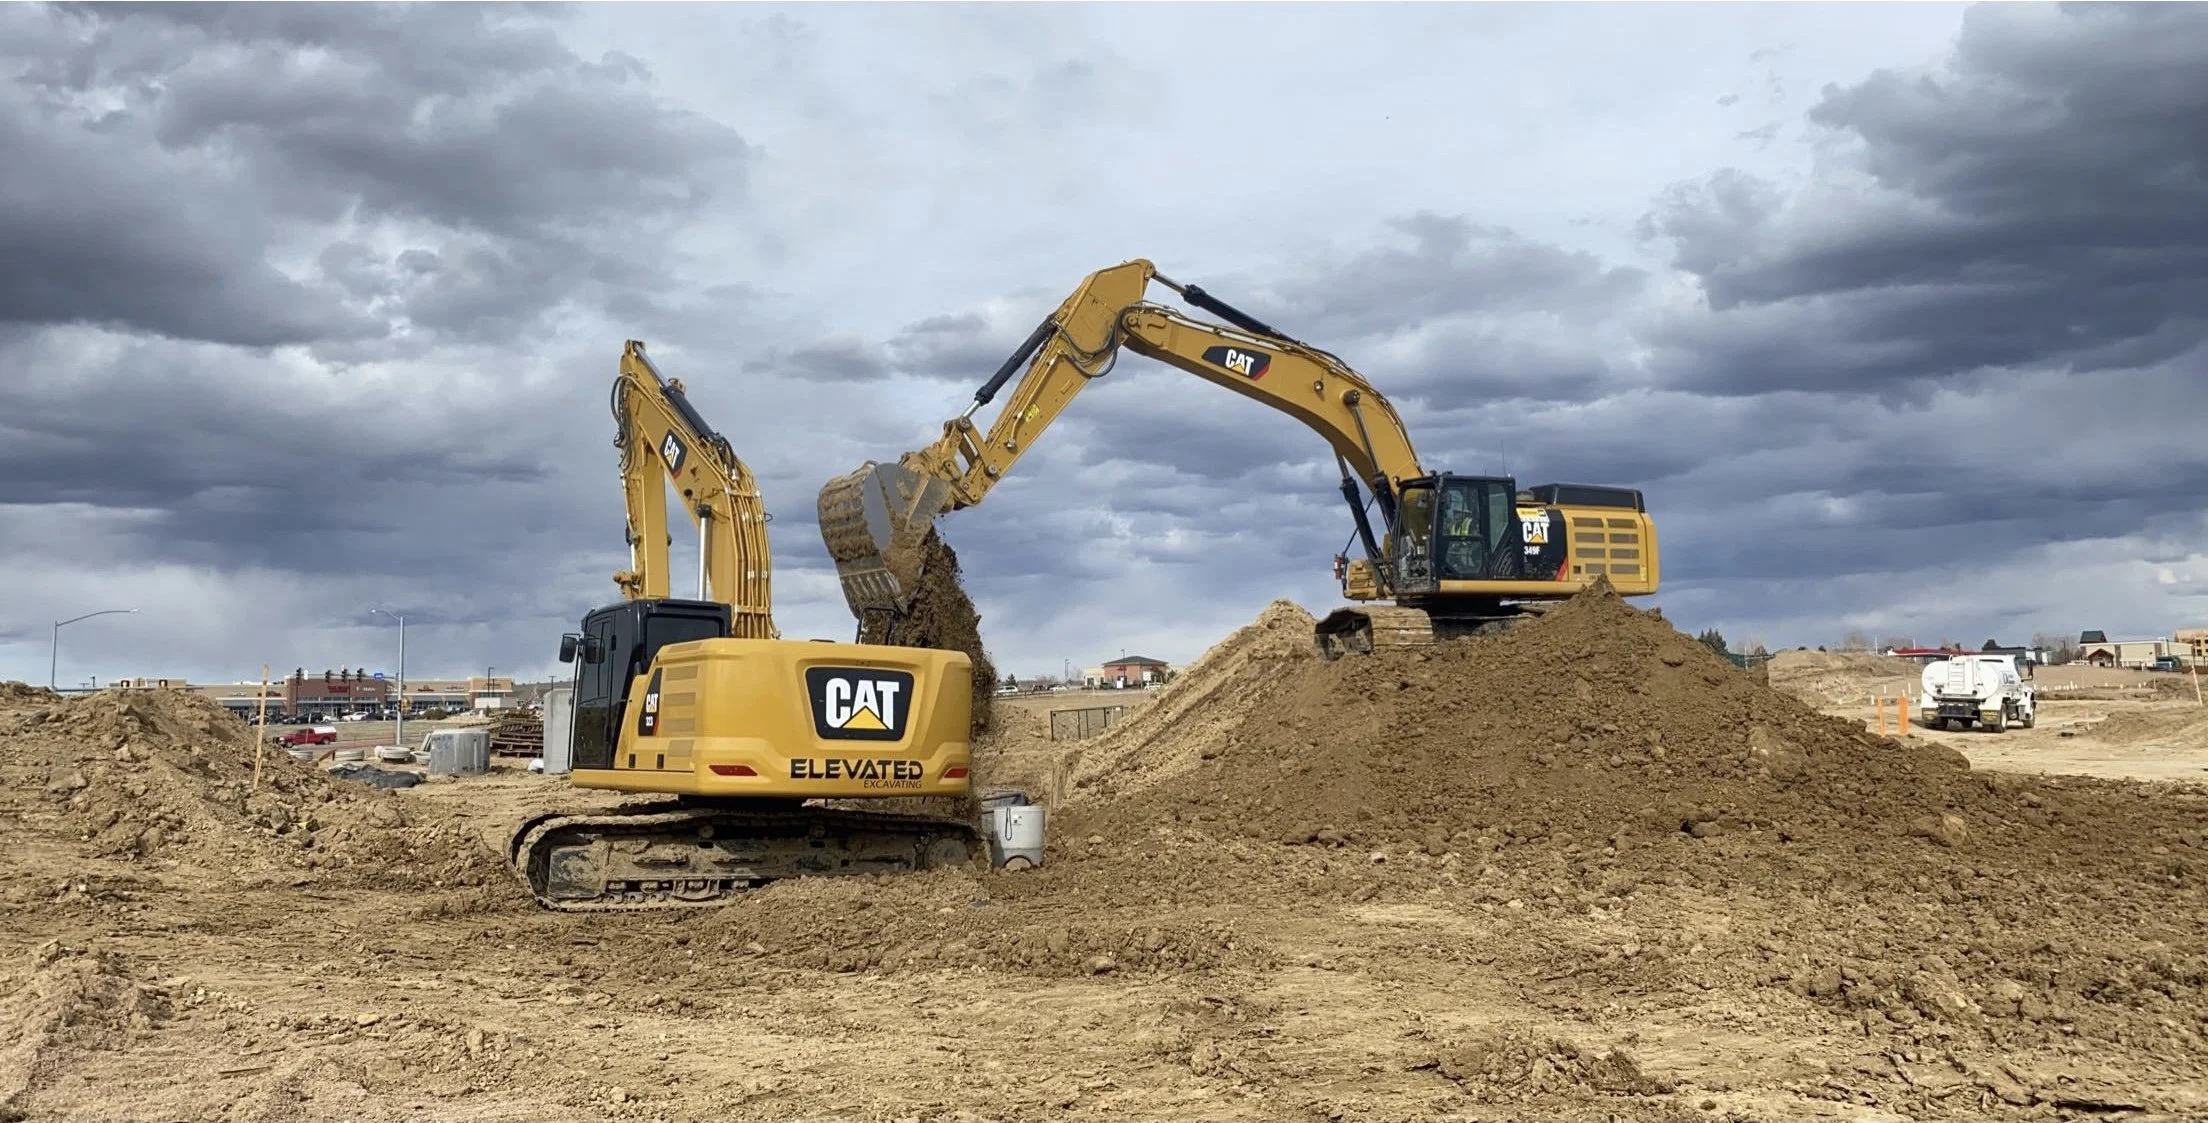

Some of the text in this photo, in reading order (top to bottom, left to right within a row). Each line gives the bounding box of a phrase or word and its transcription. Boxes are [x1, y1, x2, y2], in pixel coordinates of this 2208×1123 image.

[1225, 349, 1254, 376] CAT
[664, 435, 680, 469] CAT
[1522, 522, 1549, 543] CAT
[646, 693, 659, 712] CAT
[826, 678, 899, 729] CAT
[790, 759, 923, 779] ELEVATED
[863, 780, 922, 789] EXCAVATING
